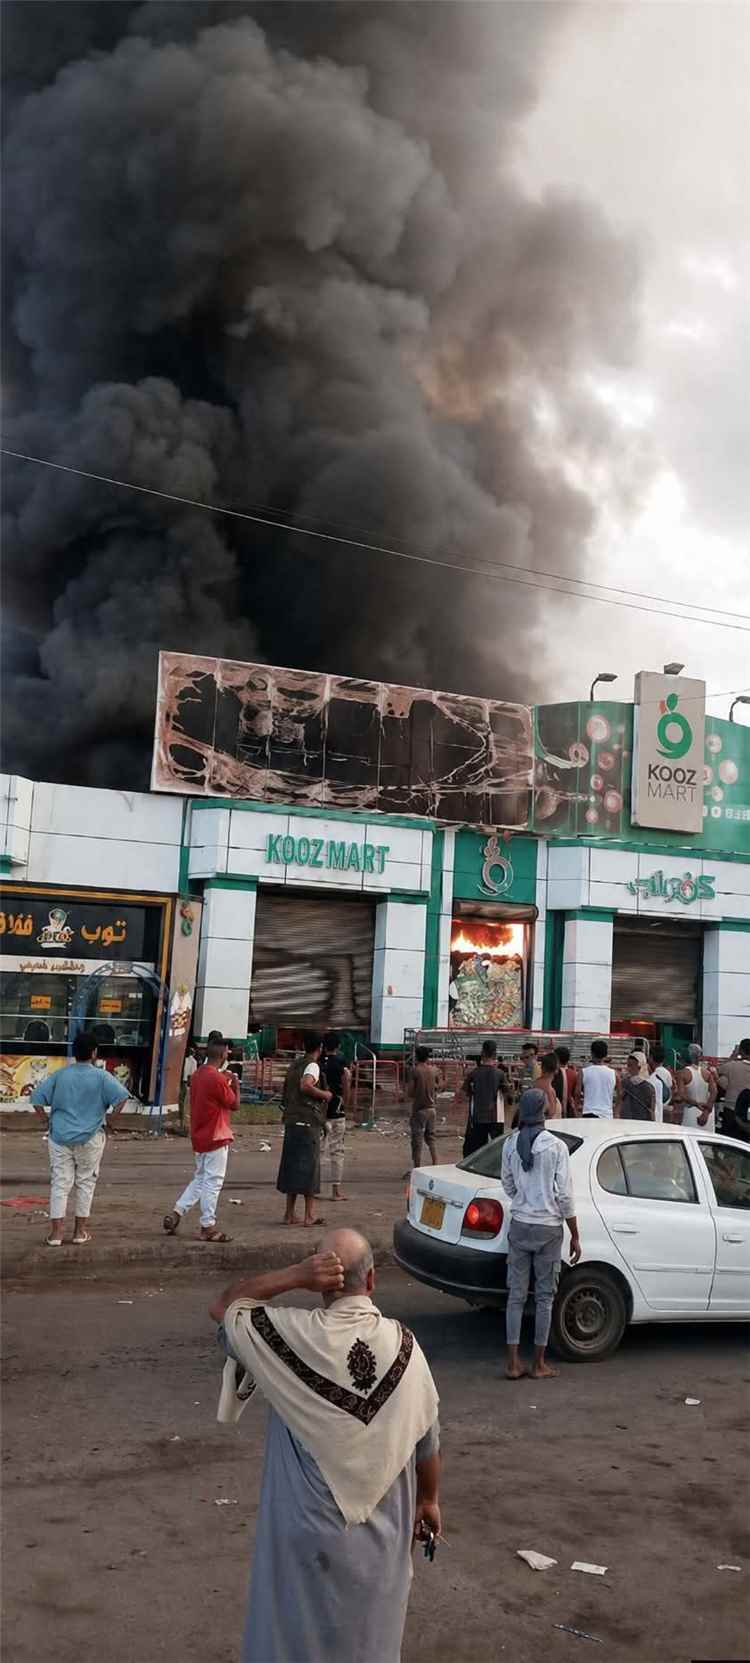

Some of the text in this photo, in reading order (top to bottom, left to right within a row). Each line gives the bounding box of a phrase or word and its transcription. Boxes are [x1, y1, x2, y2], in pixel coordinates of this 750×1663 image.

[647, 763, 697, 786] KOOZ
[647, 783, 697, 802] MART
[265, 833, 390, 874] KOOZ MART
[80, 920, 127, 947] توب
